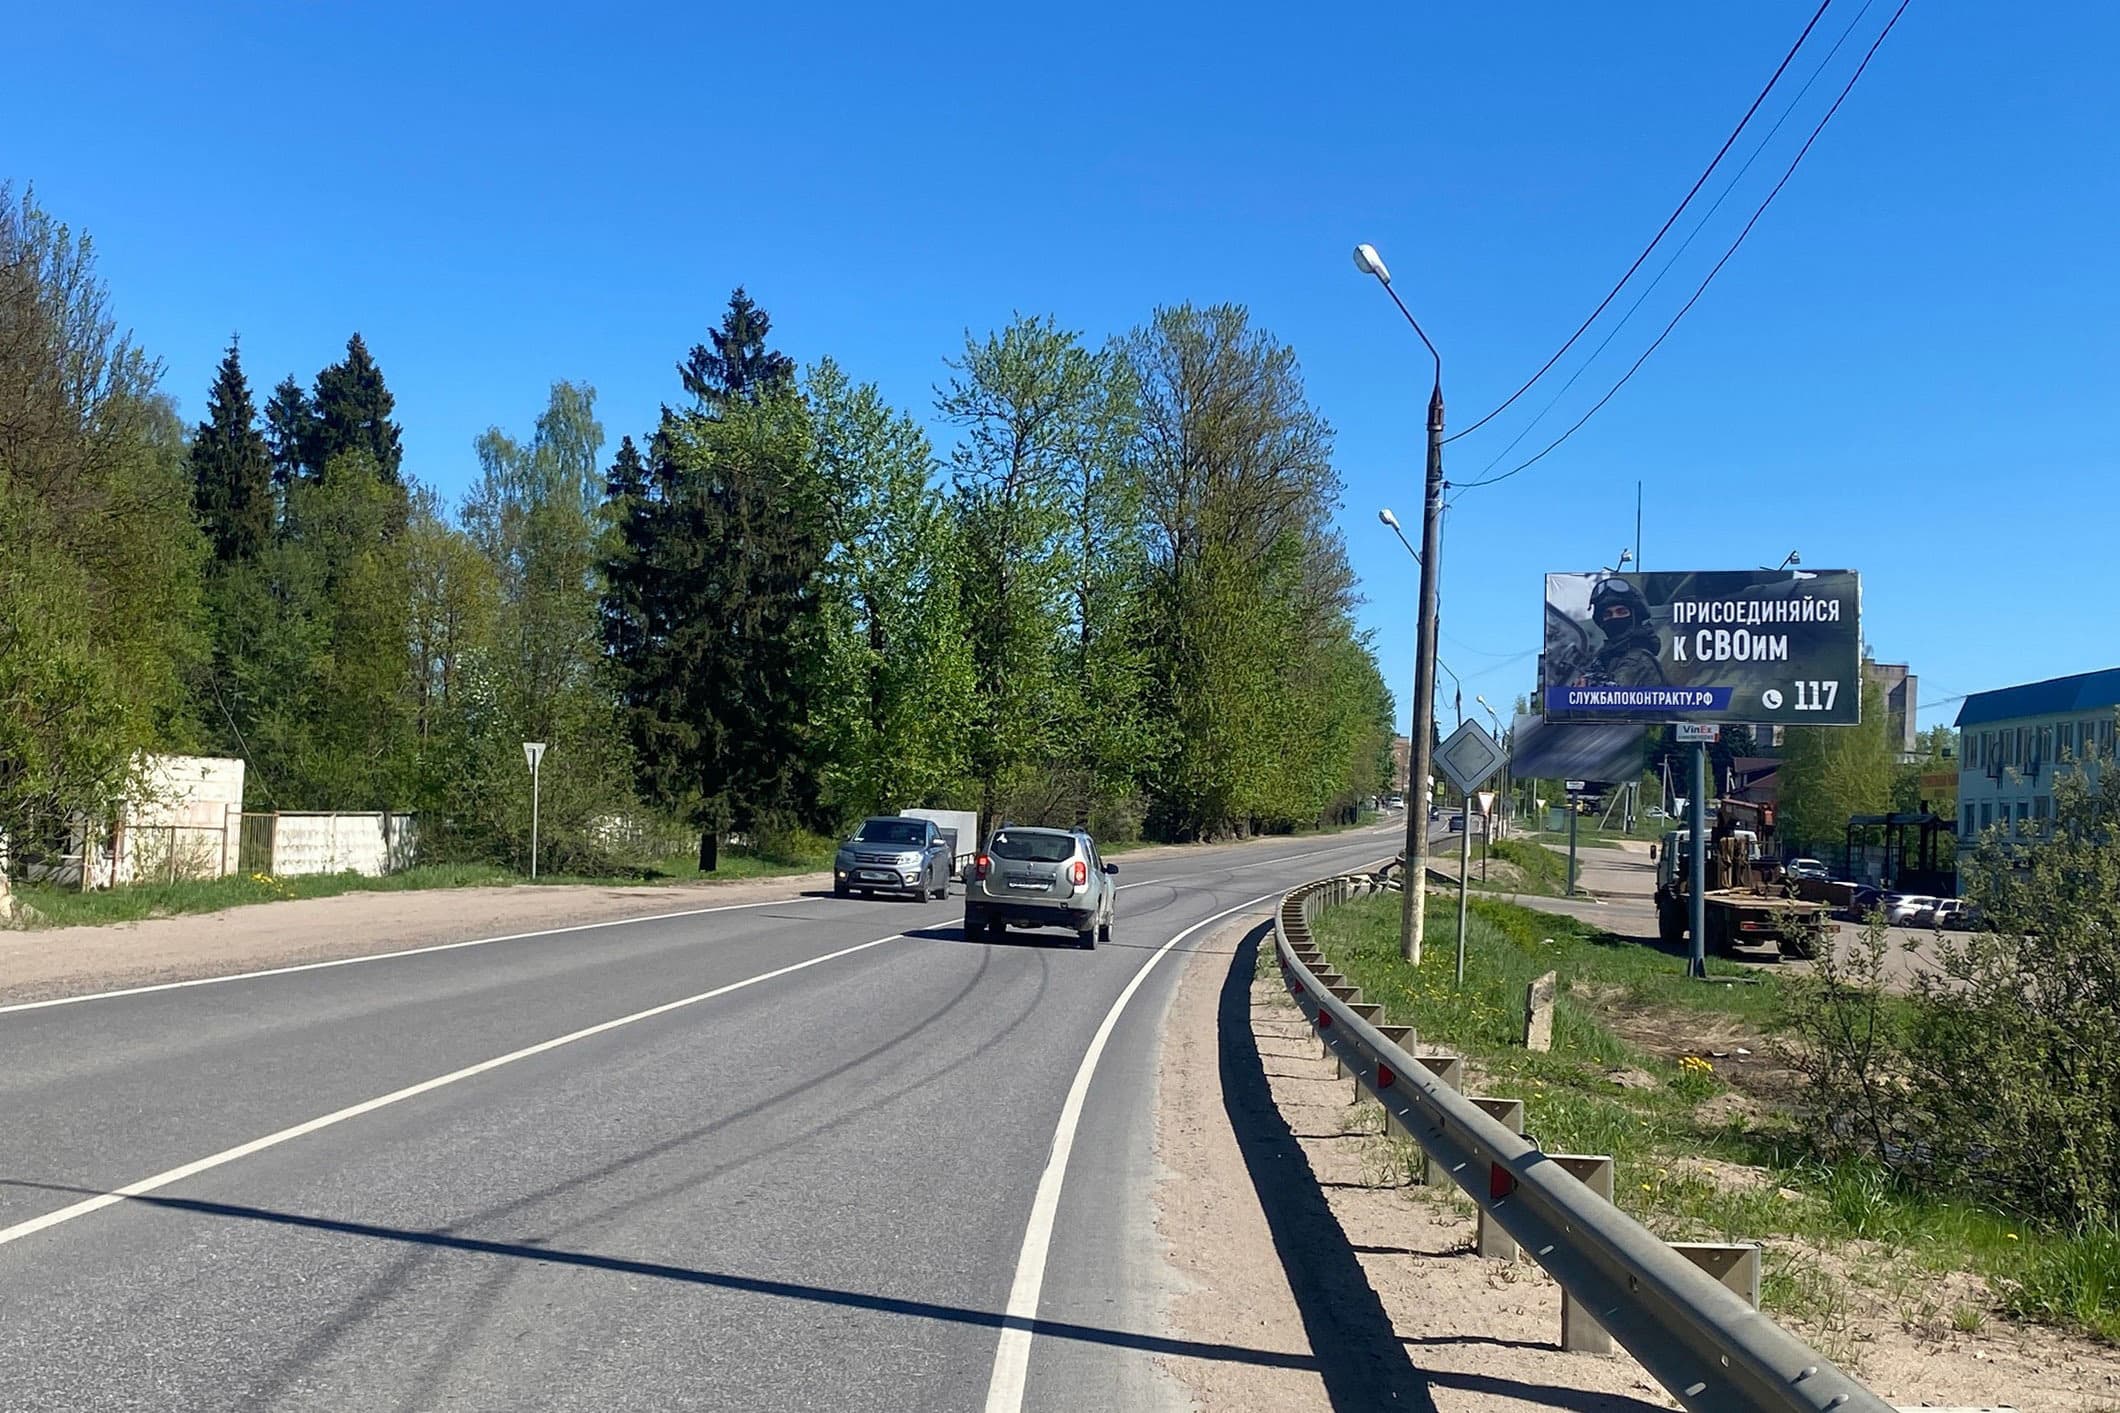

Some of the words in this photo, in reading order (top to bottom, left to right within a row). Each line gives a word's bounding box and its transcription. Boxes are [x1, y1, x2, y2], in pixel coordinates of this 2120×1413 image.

[1673, 595, 1840, 625] ПРИСОЕДИНЯЙСЯ
[1695, 628, 1788, 661] СВОим
[1568, 691, 1713, 706] СЛУЖБАПОКОНТРАКТУ.РФ
[1794, 680, 1839, 711] 117
